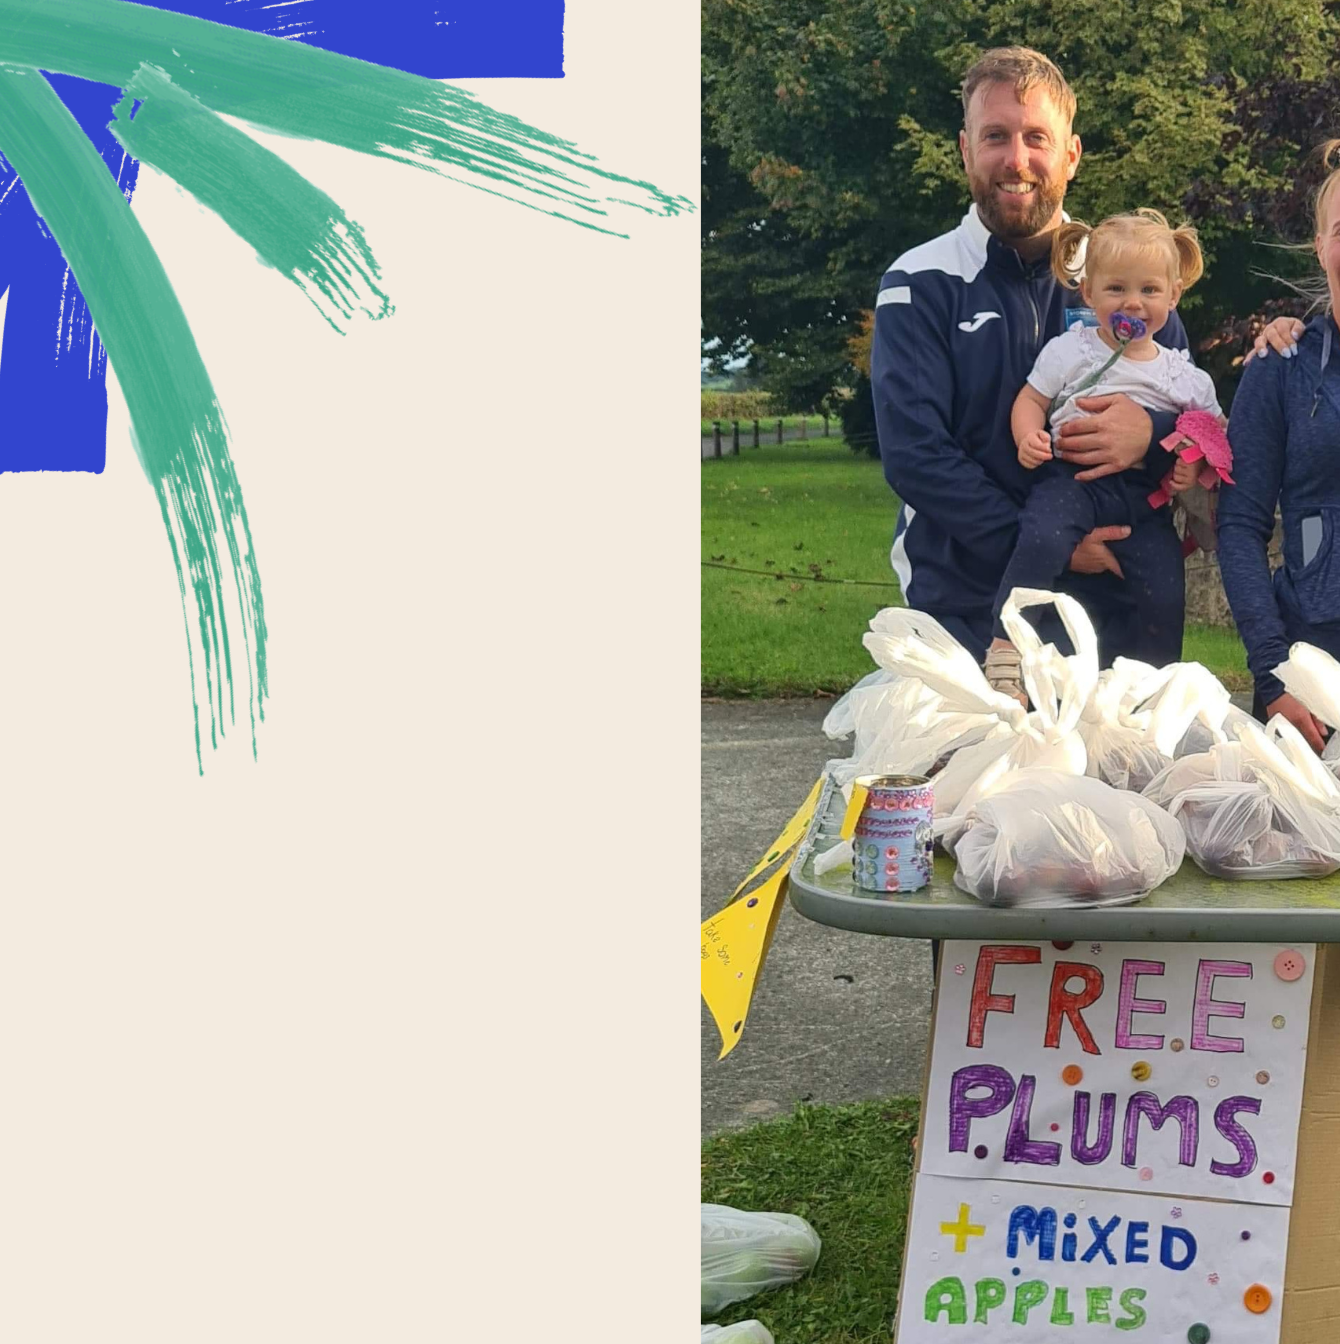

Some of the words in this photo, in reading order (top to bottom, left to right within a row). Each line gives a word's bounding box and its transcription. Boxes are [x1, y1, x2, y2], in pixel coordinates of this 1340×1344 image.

[966, 946, 1253, 1055] FREE
[949, 1064, 1262, 1177] PLUMS
[924, 1276, 1147, 1331] APPLES
